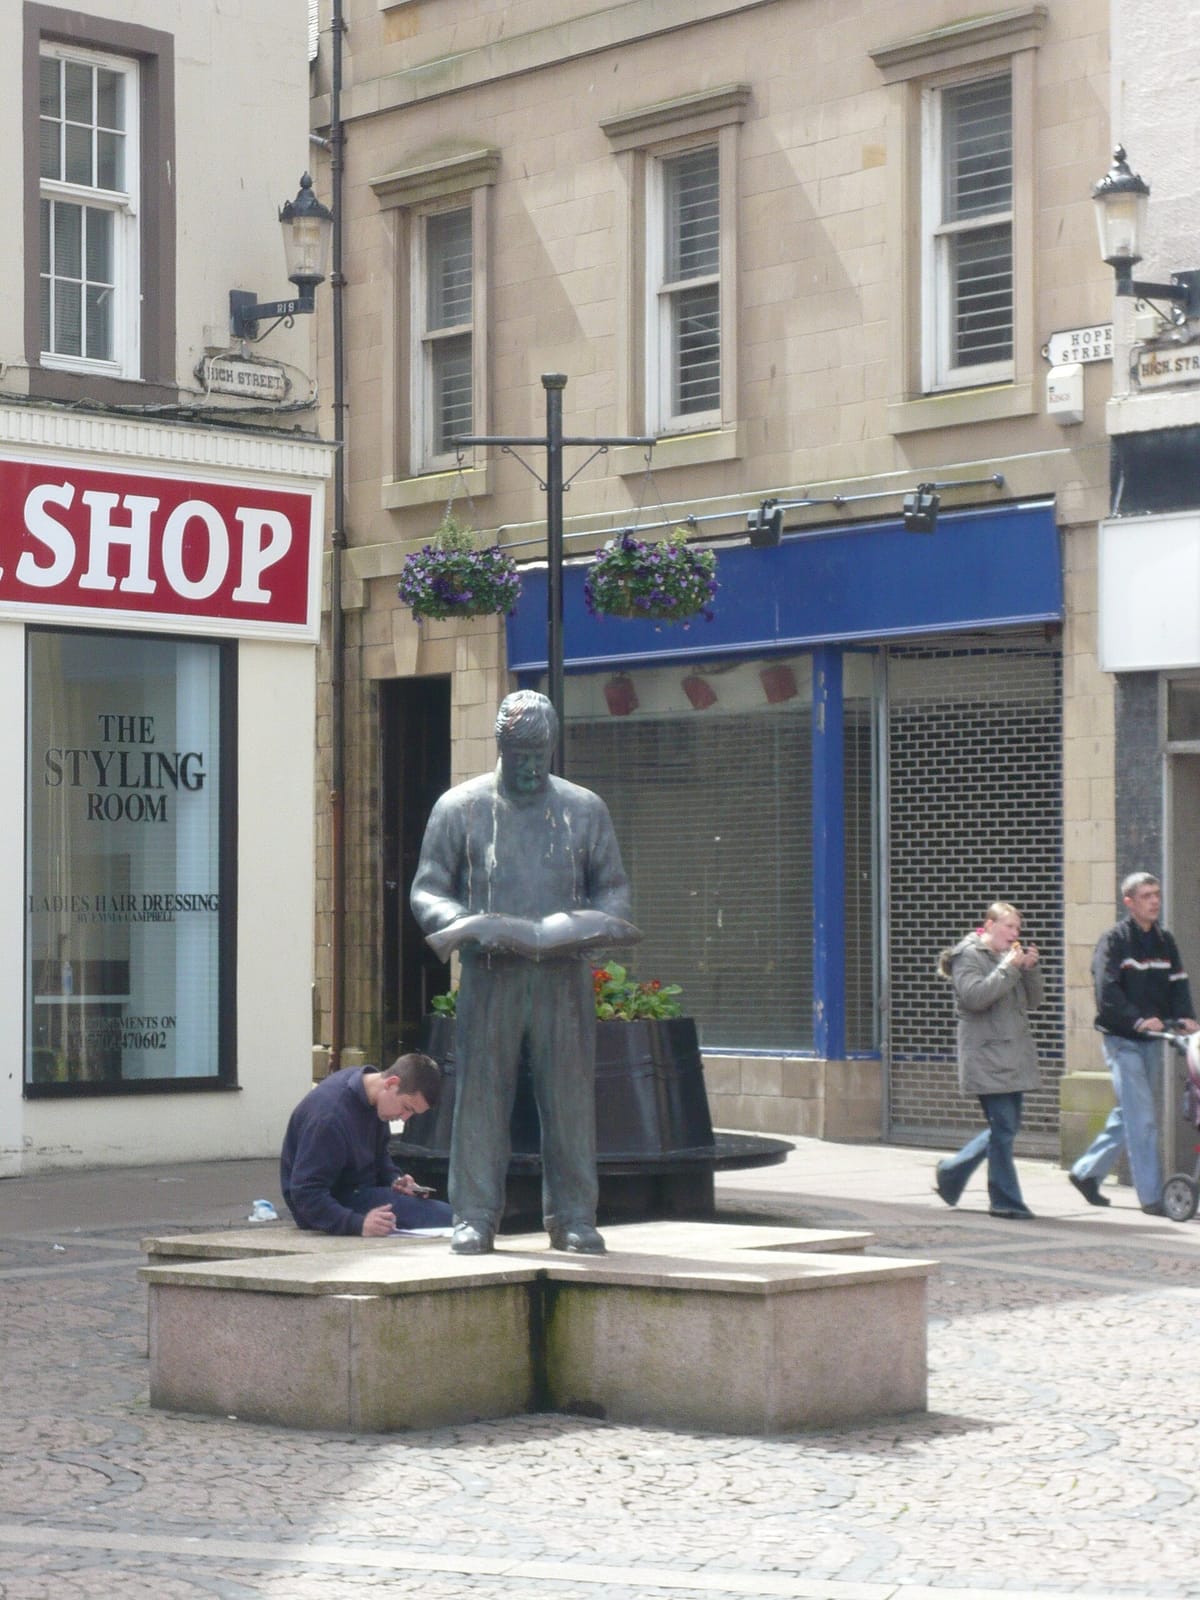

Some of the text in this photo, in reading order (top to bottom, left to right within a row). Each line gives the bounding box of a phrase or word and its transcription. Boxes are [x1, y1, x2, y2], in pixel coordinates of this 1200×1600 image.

[1071, 328, 1112, 346] HOPE
[237, 372, 281, 390] STREET
[15, 481, 293, 604] SHOP
[98, 714, 155, 744] THE
[45, 748, 206, 791] STYLING
[87, 793, 168, 822] ROOM
[29, 894, 219, 912] LADIES HAIR DRESSING
[161, 1015, 177, 1029] ON
